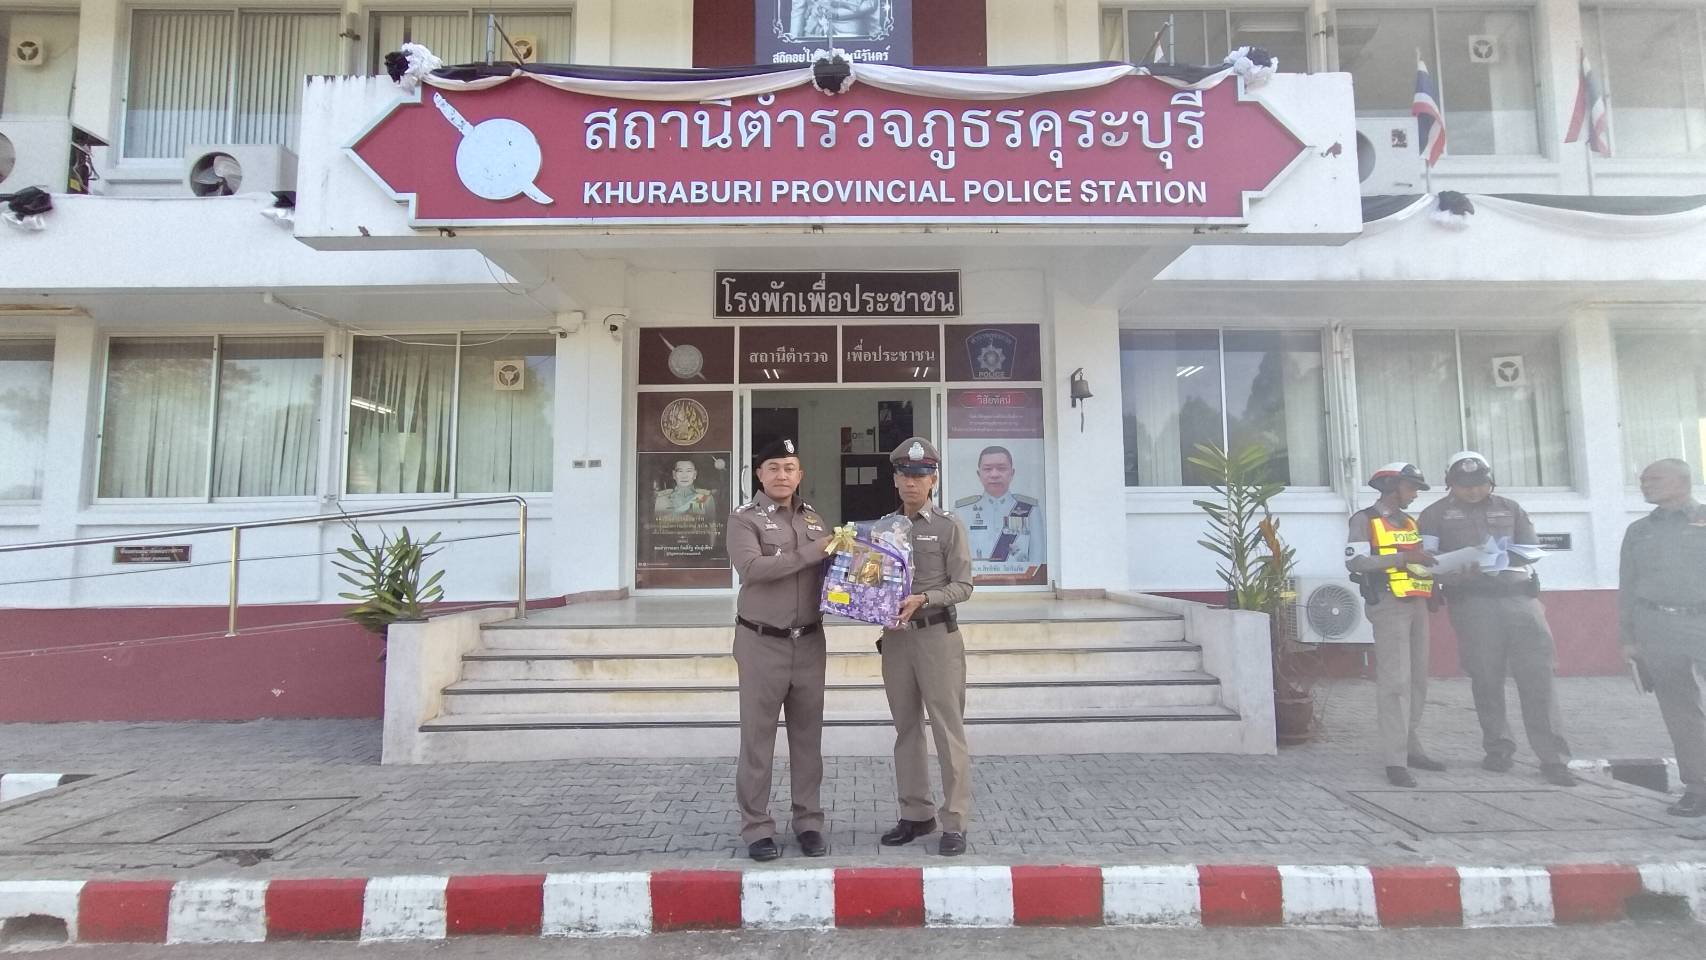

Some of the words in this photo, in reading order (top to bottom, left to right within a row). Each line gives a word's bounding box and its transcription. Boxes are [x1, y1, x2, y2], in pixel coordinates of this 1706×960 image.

[583, 180, 761, 204] KHURABURI
[772, 180, 956, 203] PROVINCIAL
[963, 180, 1072, 203] POLICE
[1080, 180, 1207, 203] STATION
[721, 272, 955, 313] โรงพักเพื่อประชาชน
[749, 345, 829, 363] สถานีตำรวจ
[846, 338, 936, 362] เพื่อประชาชน
